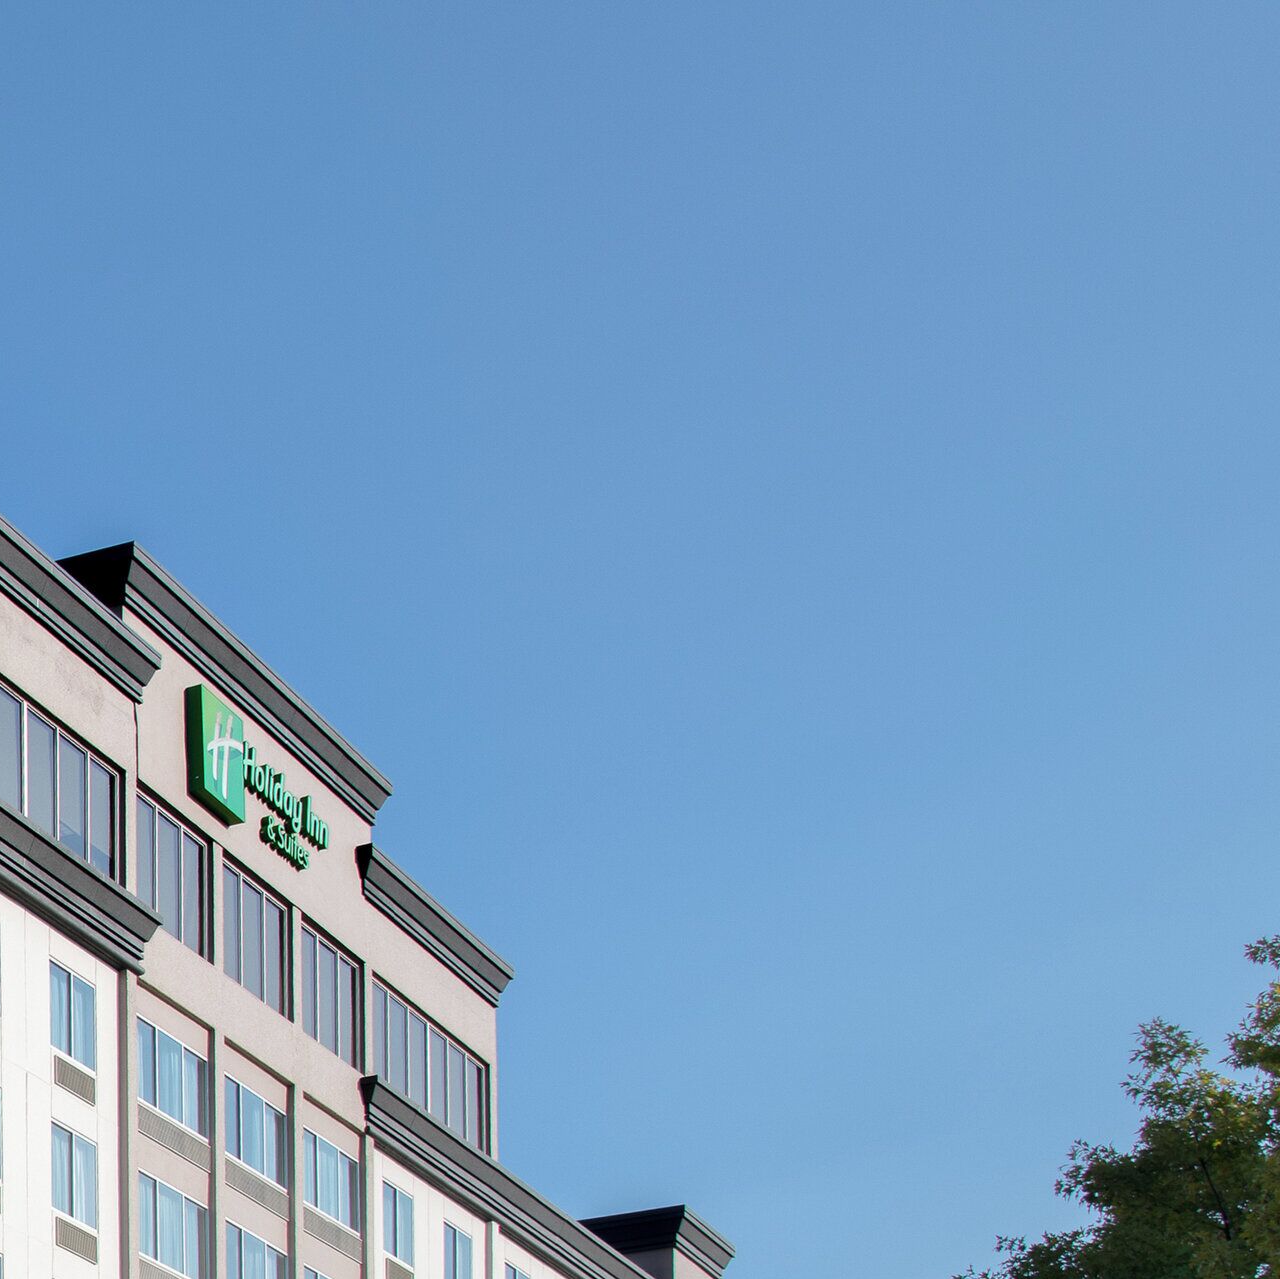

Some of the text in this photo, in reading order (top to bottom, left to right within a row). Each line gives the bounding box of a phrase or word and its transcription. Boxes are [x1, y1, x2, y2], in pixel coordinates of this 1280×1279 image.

[243, 741, 329, 850] Holiday Inn
[277, 824, 309, 869] Suites
